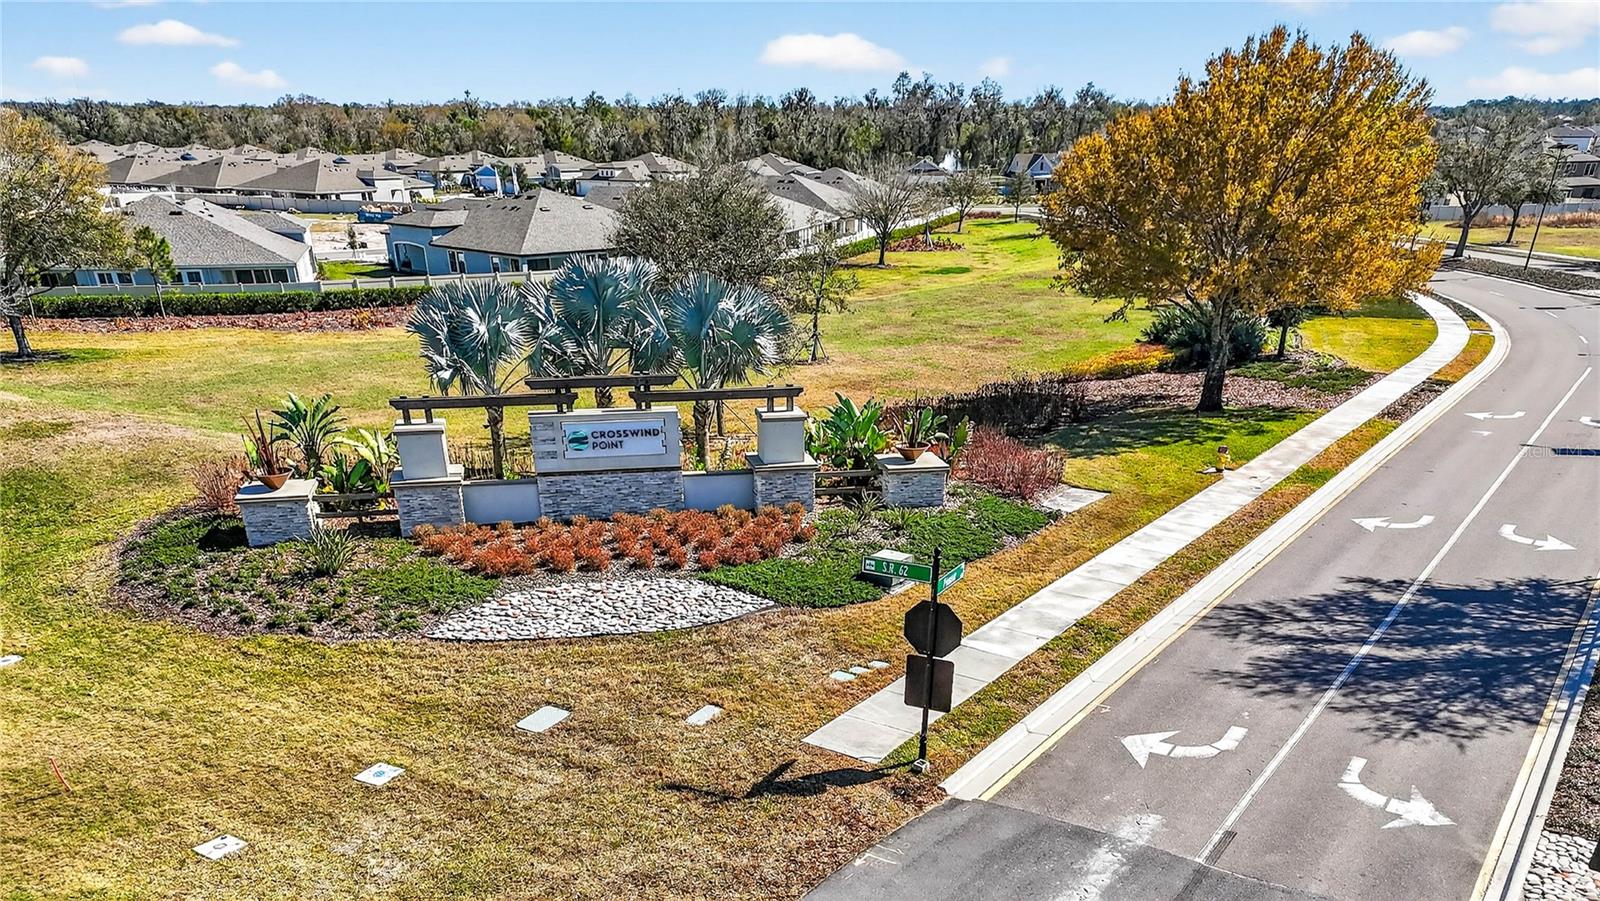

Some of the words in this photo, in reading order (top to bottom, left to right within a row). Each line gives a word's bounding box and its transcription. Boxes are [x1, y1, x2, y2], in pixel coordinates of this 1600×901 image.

[591, 428, 660, 440] CROSSWIND
[592, 440, 624, 450] POINT
[882, 562, 897, 575] S.R.
[898, 565, 909, 577] 62
